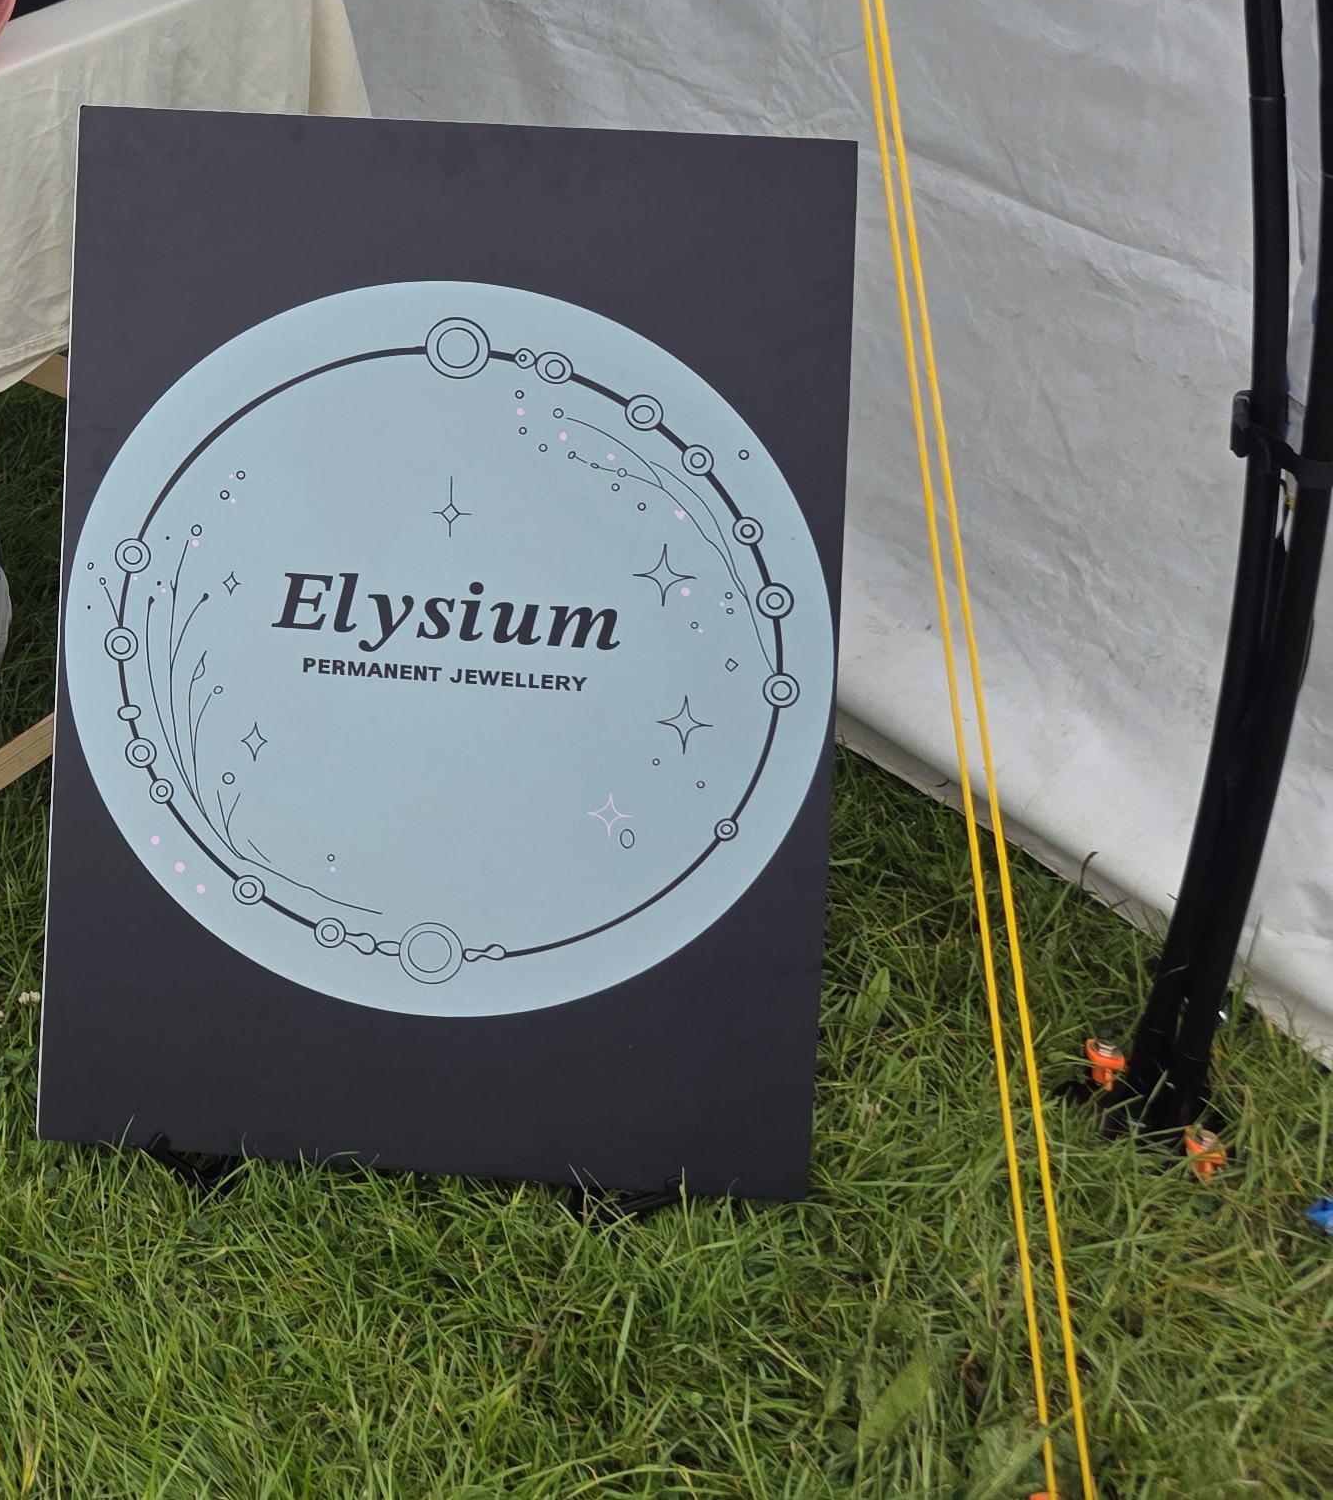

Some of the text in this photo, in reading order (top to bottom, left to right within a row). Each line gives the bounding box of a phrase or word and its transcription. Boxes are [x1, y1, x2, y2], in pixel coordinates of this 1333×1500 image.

[271, 572, 621, 652] Elysium
[302, 657, 588, 693] PERMANENT JEWELLERY
